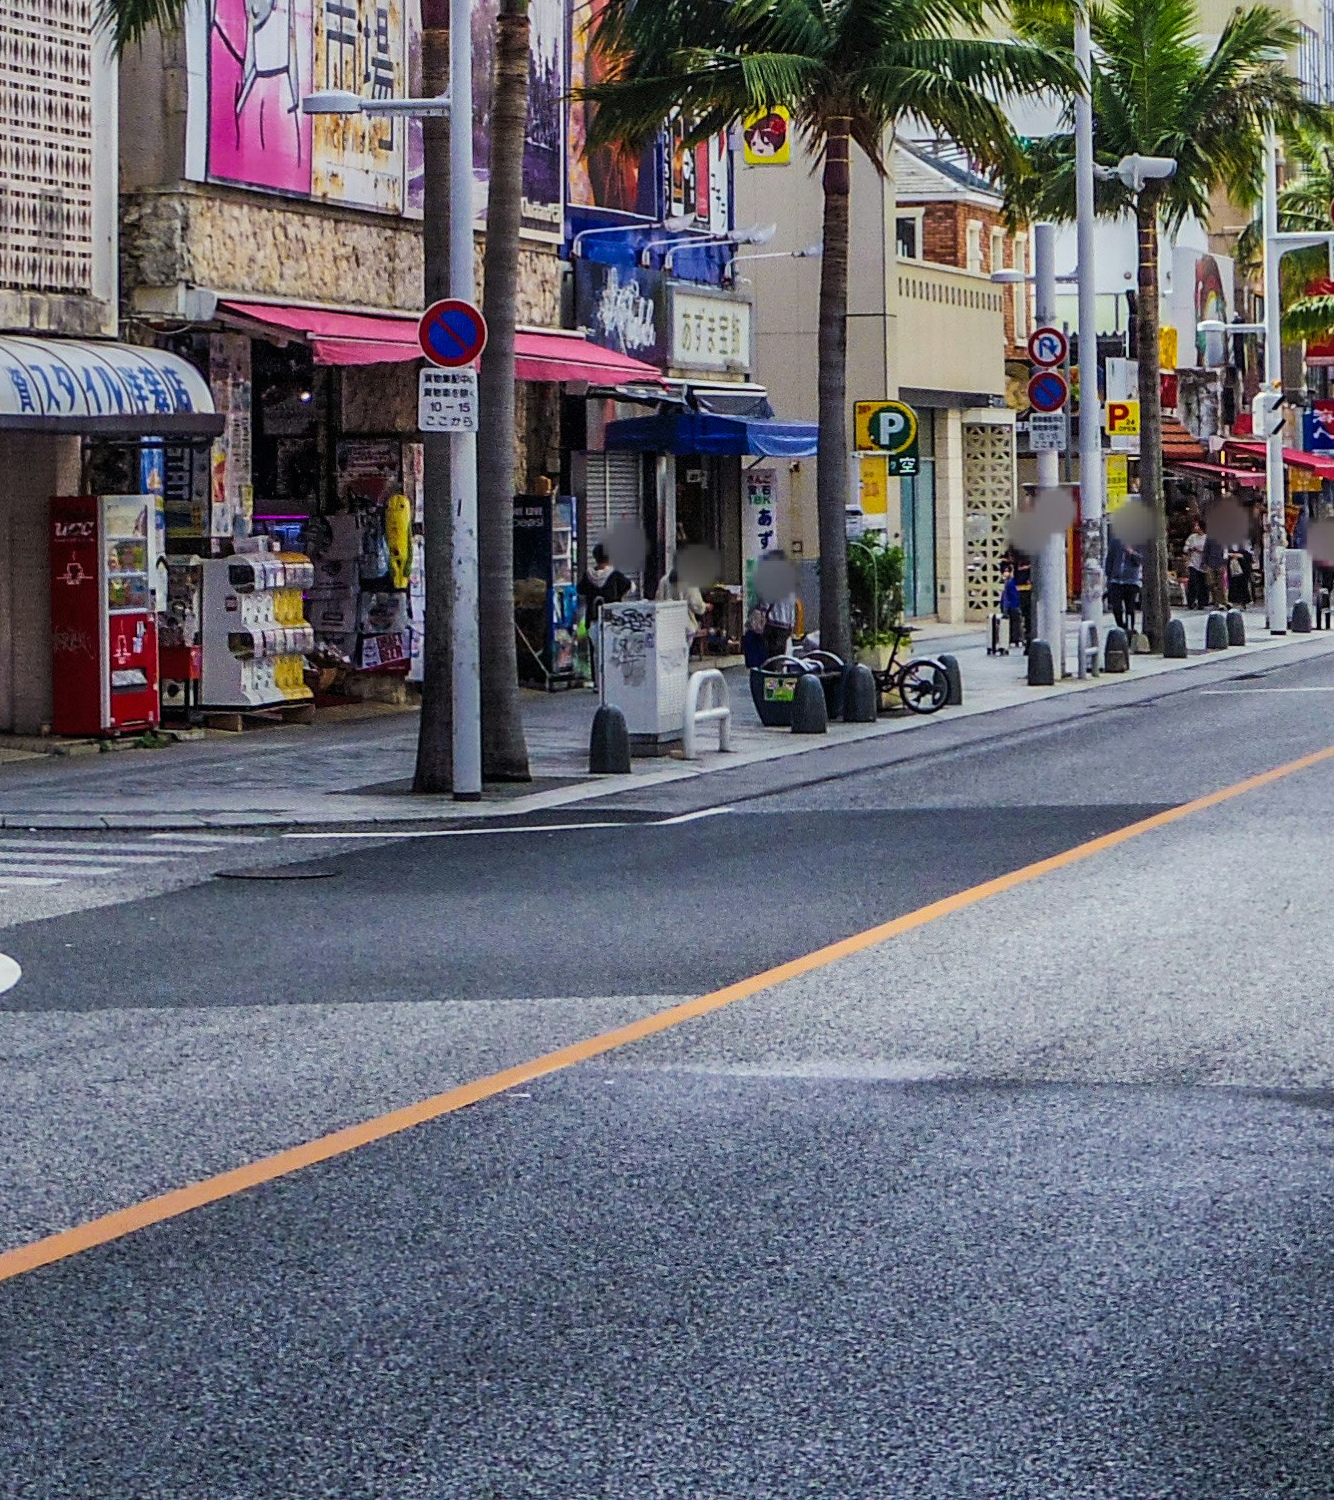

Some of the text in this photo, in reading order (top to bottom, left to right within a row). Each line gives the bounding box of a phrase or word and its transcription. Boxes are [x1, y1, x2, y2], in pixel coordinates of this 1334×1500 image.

[426, 415, 474, 428] ここから
[879, 411, 905, 446] P
[1108, 403, 1130, 432] P
